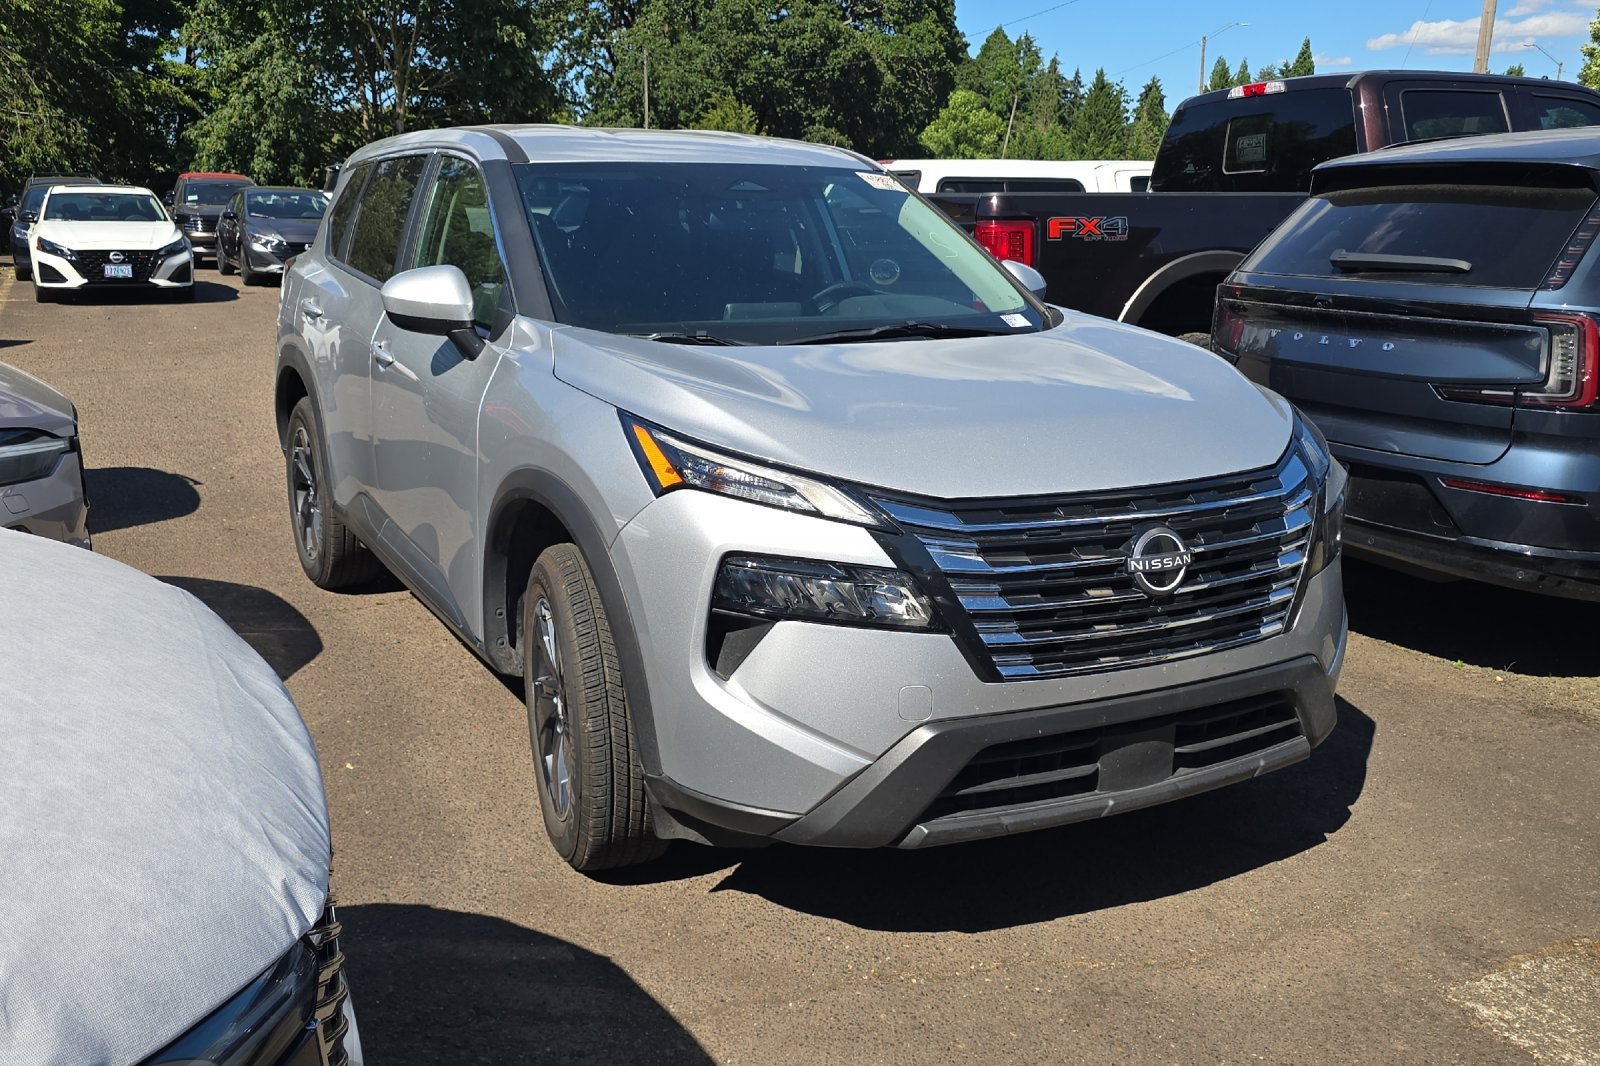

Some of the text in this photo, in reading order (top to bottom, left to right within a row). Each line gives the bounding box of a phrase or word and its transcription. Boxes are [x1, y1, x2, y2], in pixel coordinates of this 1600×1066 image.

[1047, 217, 1128, 241] FX4
[1270, 328, 1395, 351] VOLVO
[1130, 553, 1191, 571] NISSAN
